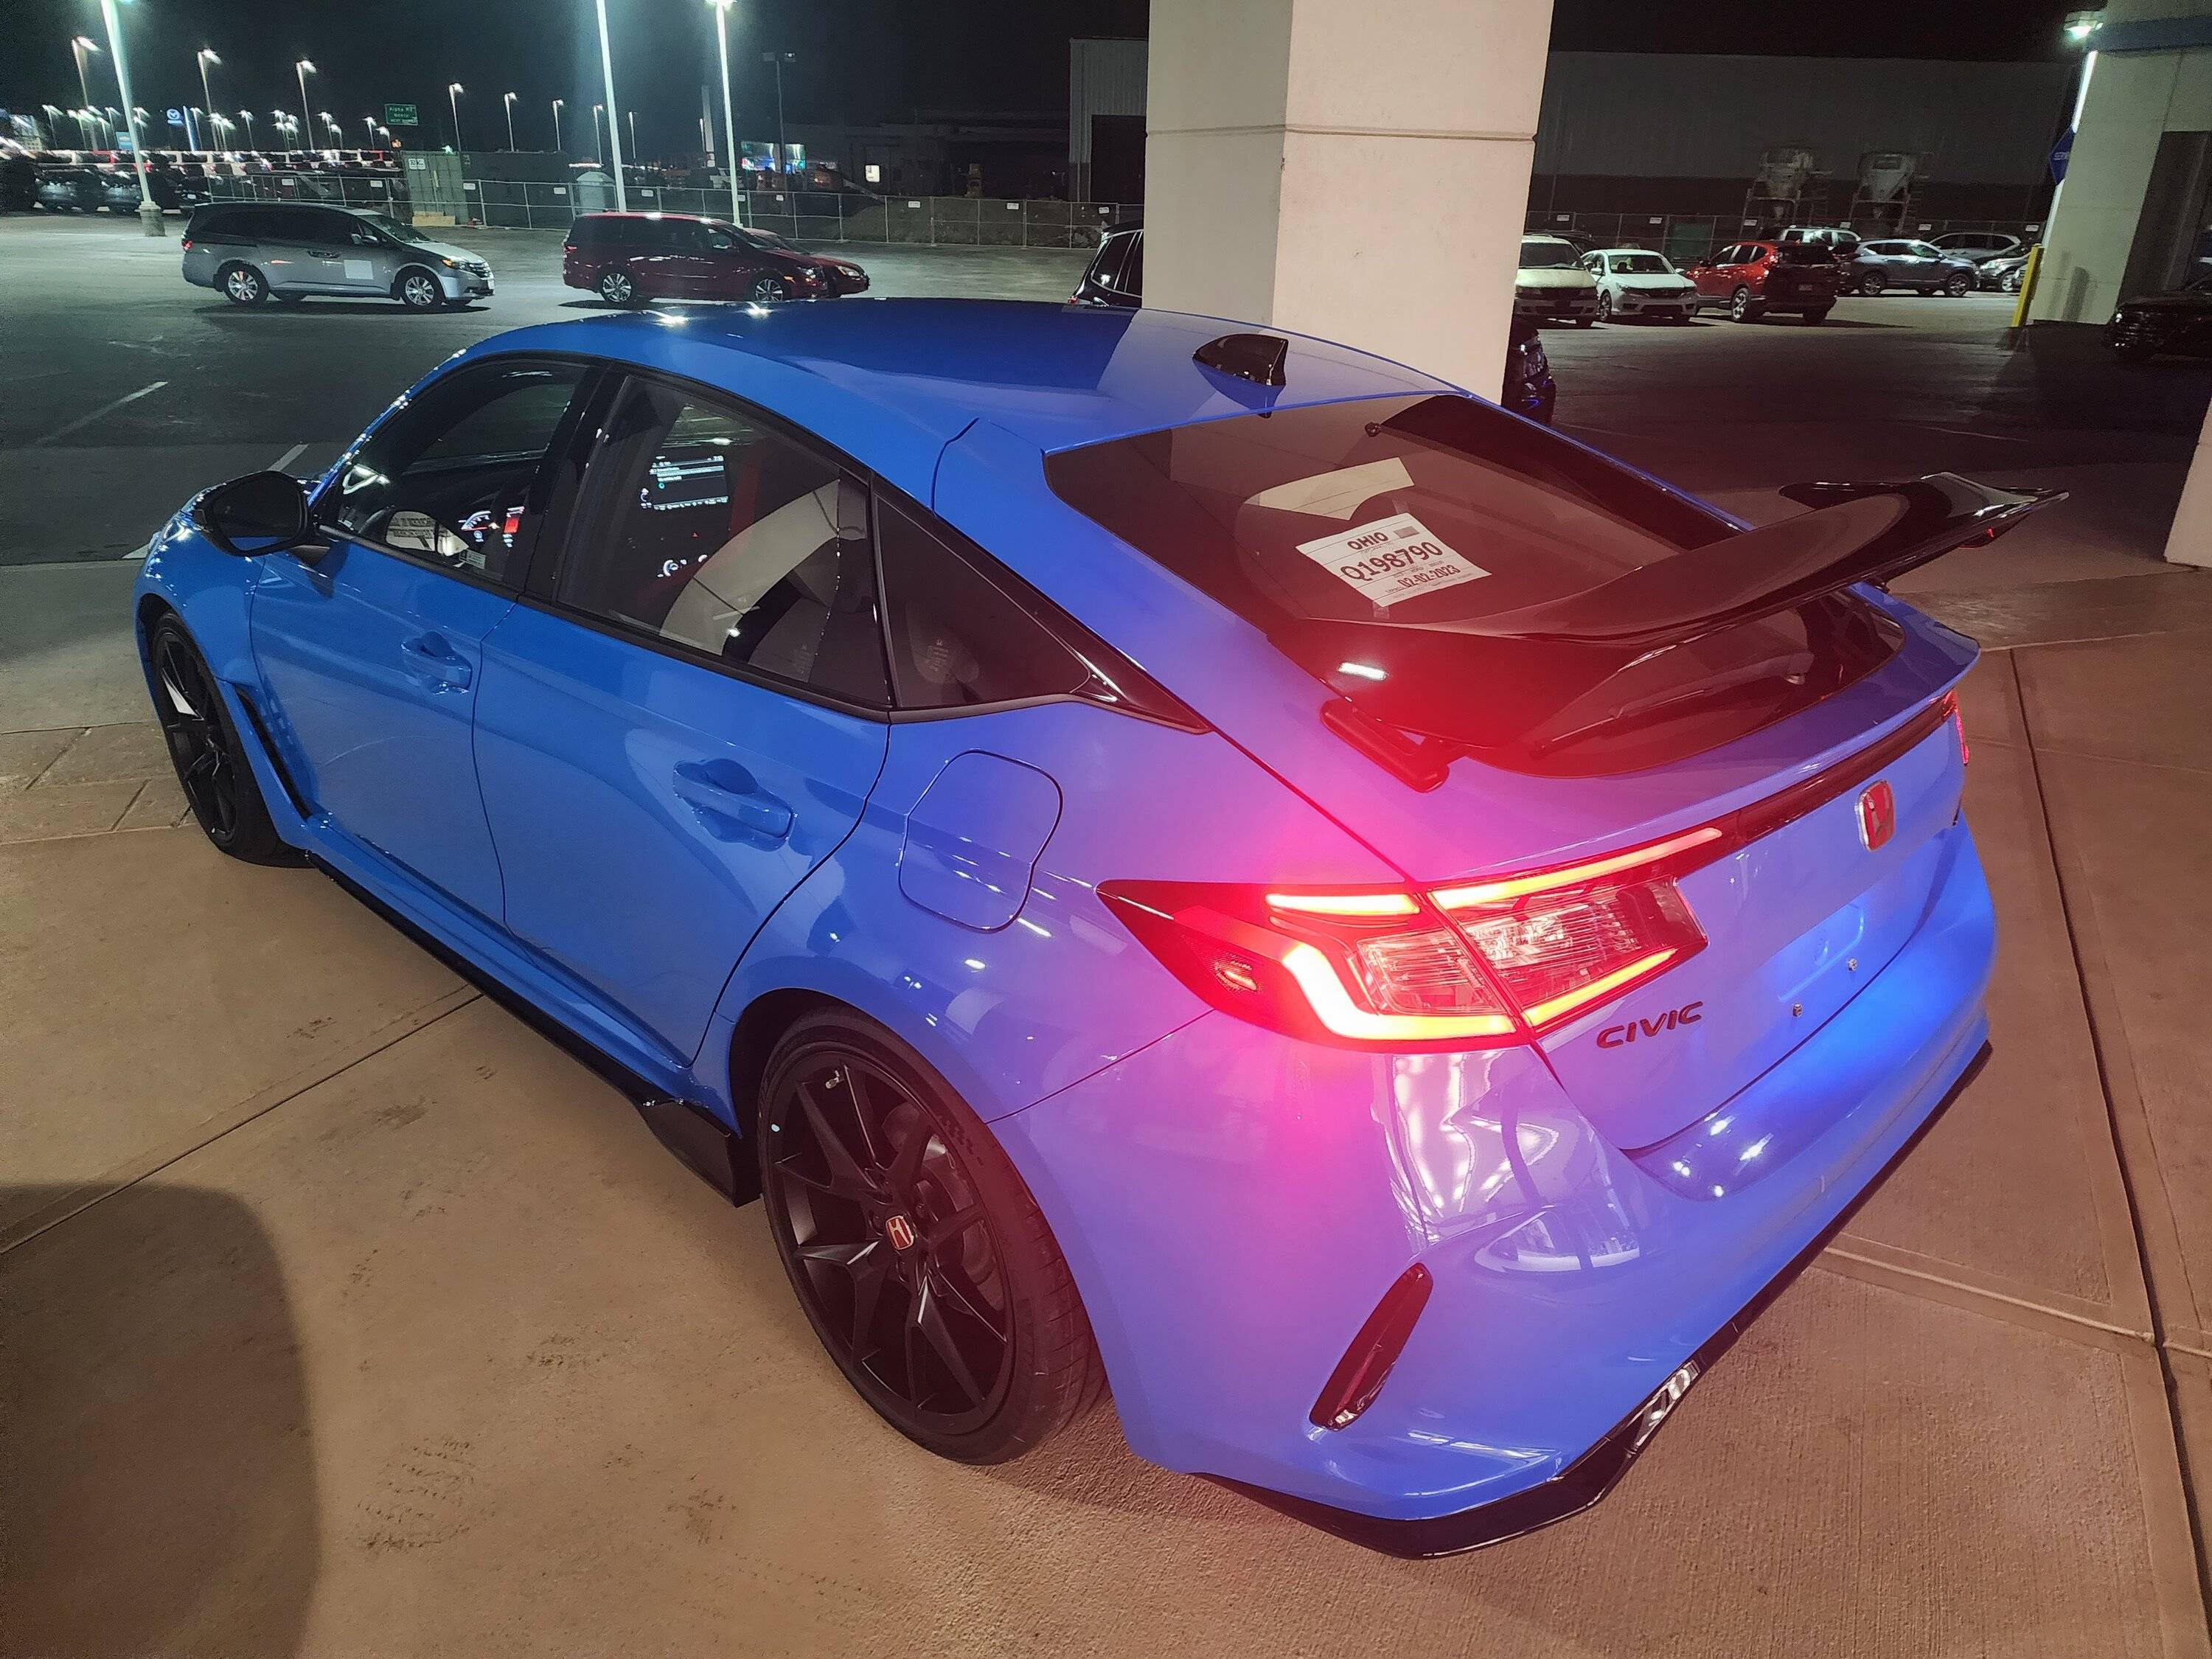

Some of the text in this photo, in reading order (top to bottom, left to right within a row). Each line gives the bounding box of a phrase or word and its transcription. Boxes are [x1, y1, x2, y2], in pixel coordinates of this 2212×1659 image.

[1347, 532, 1388, 550] OHIO
[1340, 541, 1444, 582] Q198790
[1397, 564, 1461, 588] 02-02-2023
[1596, 1001, 1703, 1048] CIVIC
